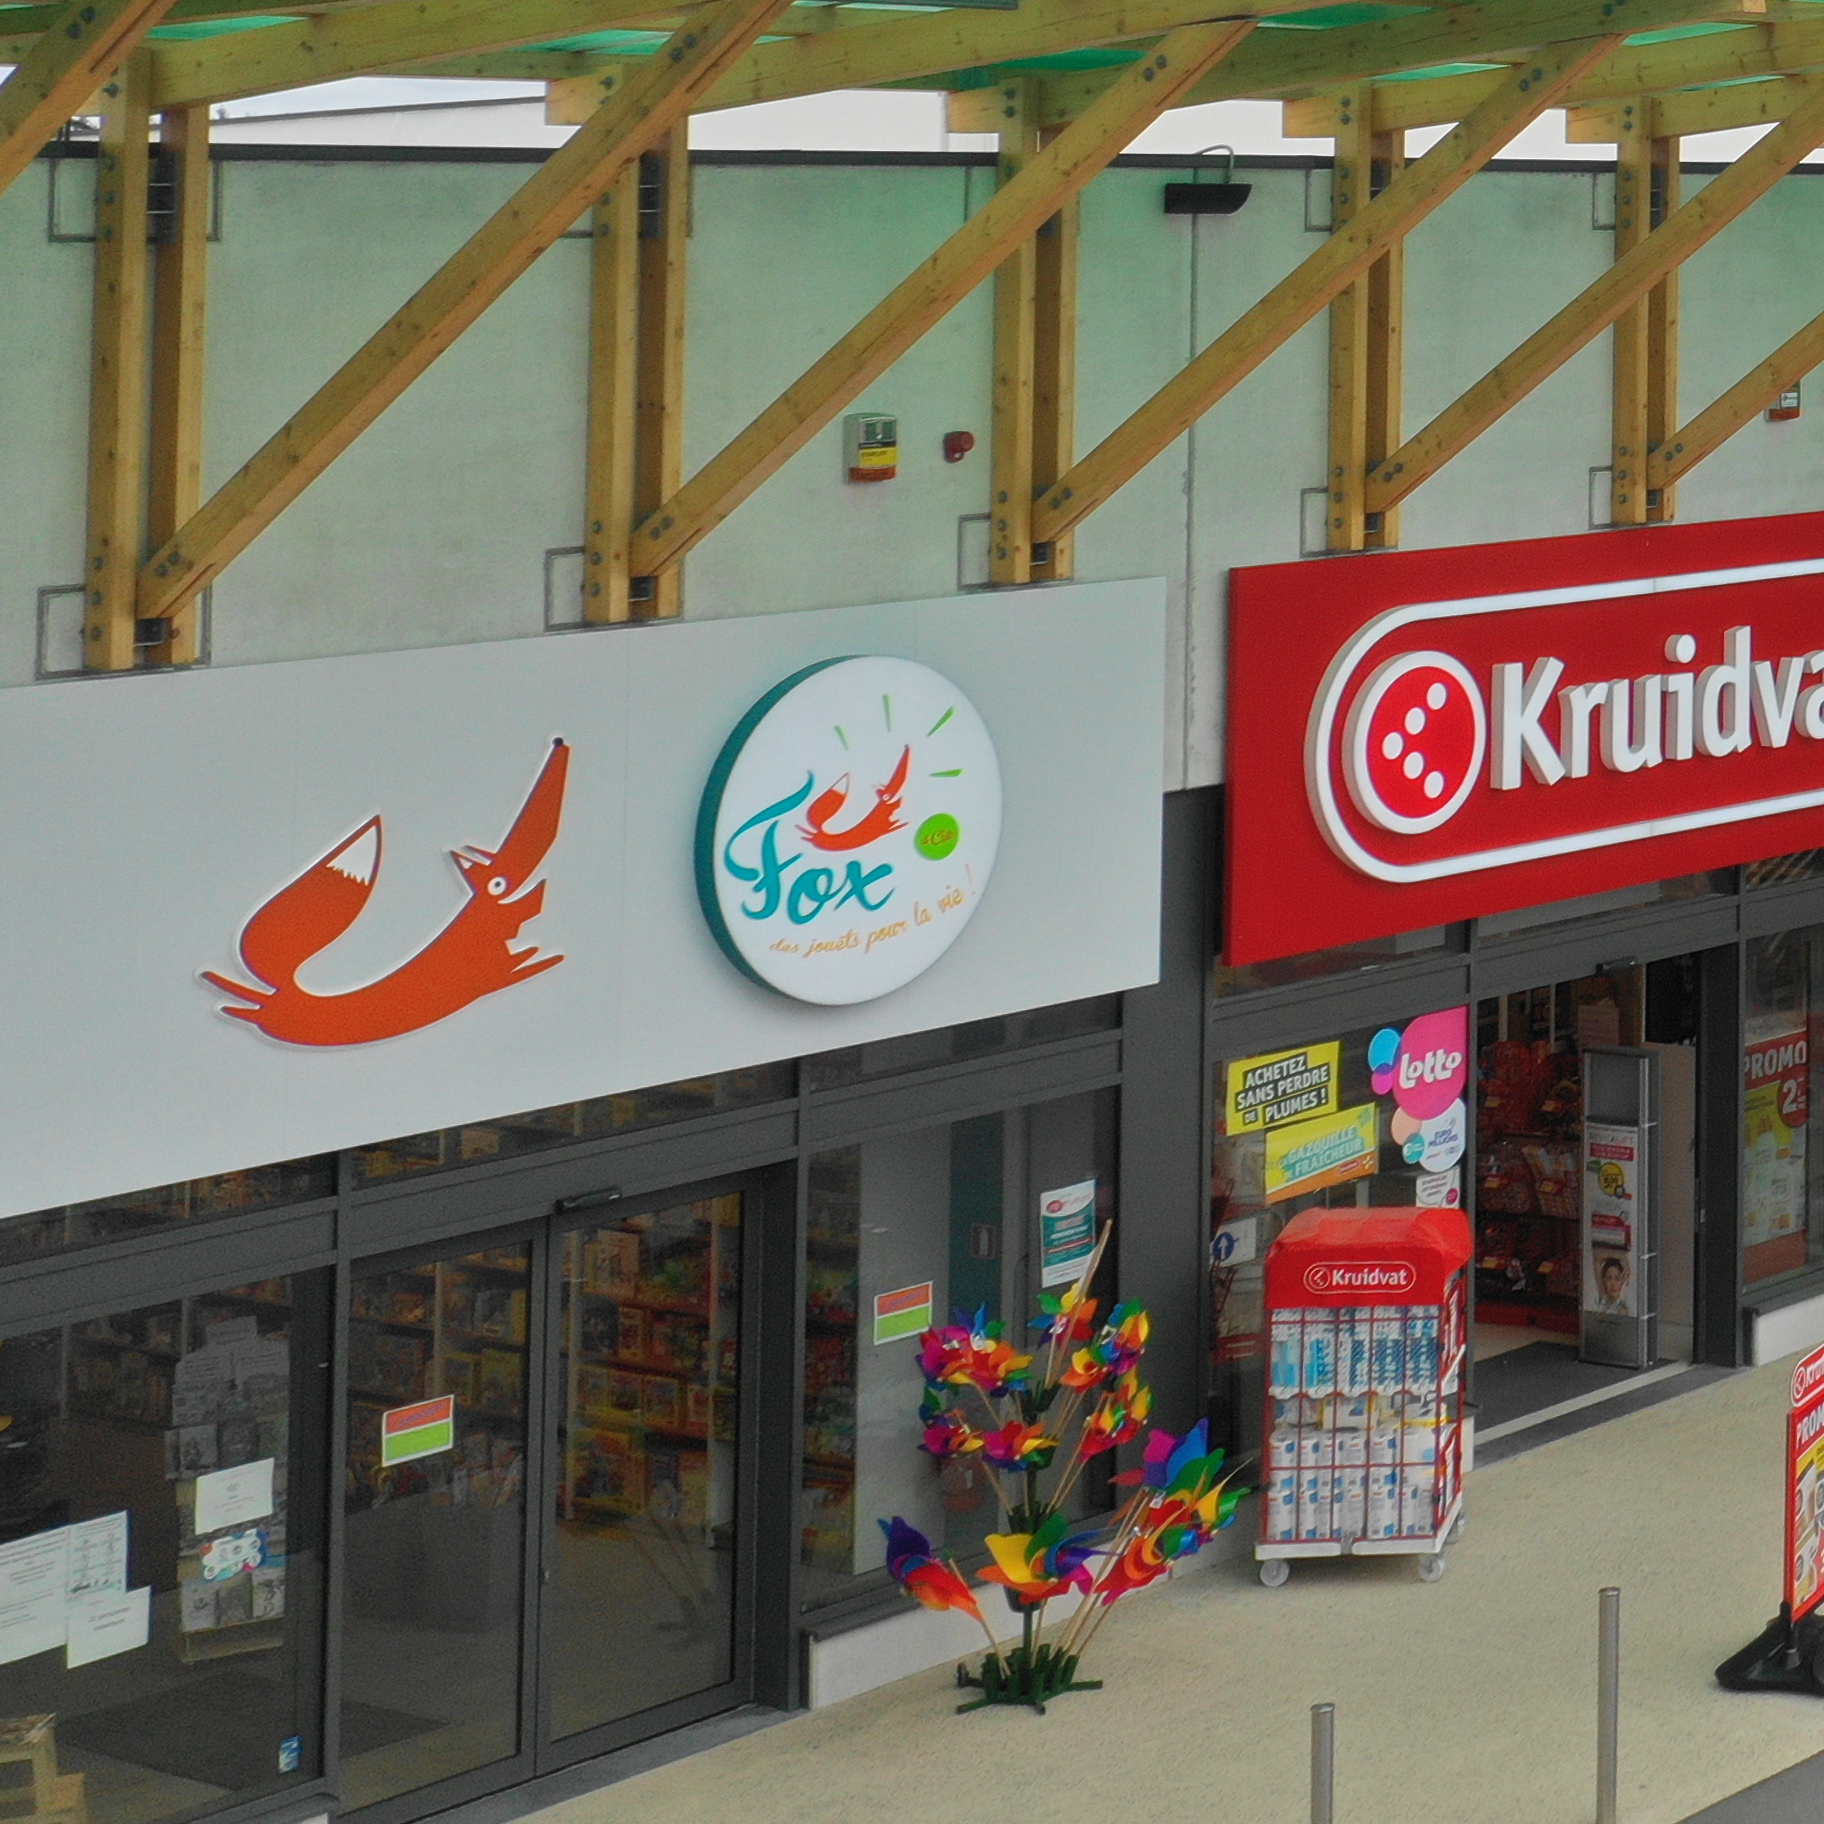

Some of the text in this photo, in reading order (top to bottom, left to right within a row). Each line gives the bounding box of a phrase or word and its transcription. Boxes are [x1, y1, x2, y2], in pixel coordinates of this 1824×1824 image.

[724, 770, 897, 925] Fox
[769, 938, 800, 954] des
[802, 929, 860, 958] jouets
[864, 920, 908, 954] pour
[913, 900, 933, 926] la
[1237, 1065, 1329, 1110] SANS PERDRE
[1245, 1055, 1306, 1088] ACHETEZ
[1265, 1091, 1318, 1123] PLUMES
[1332, 1267, 1408, 1286] Kruidvat
